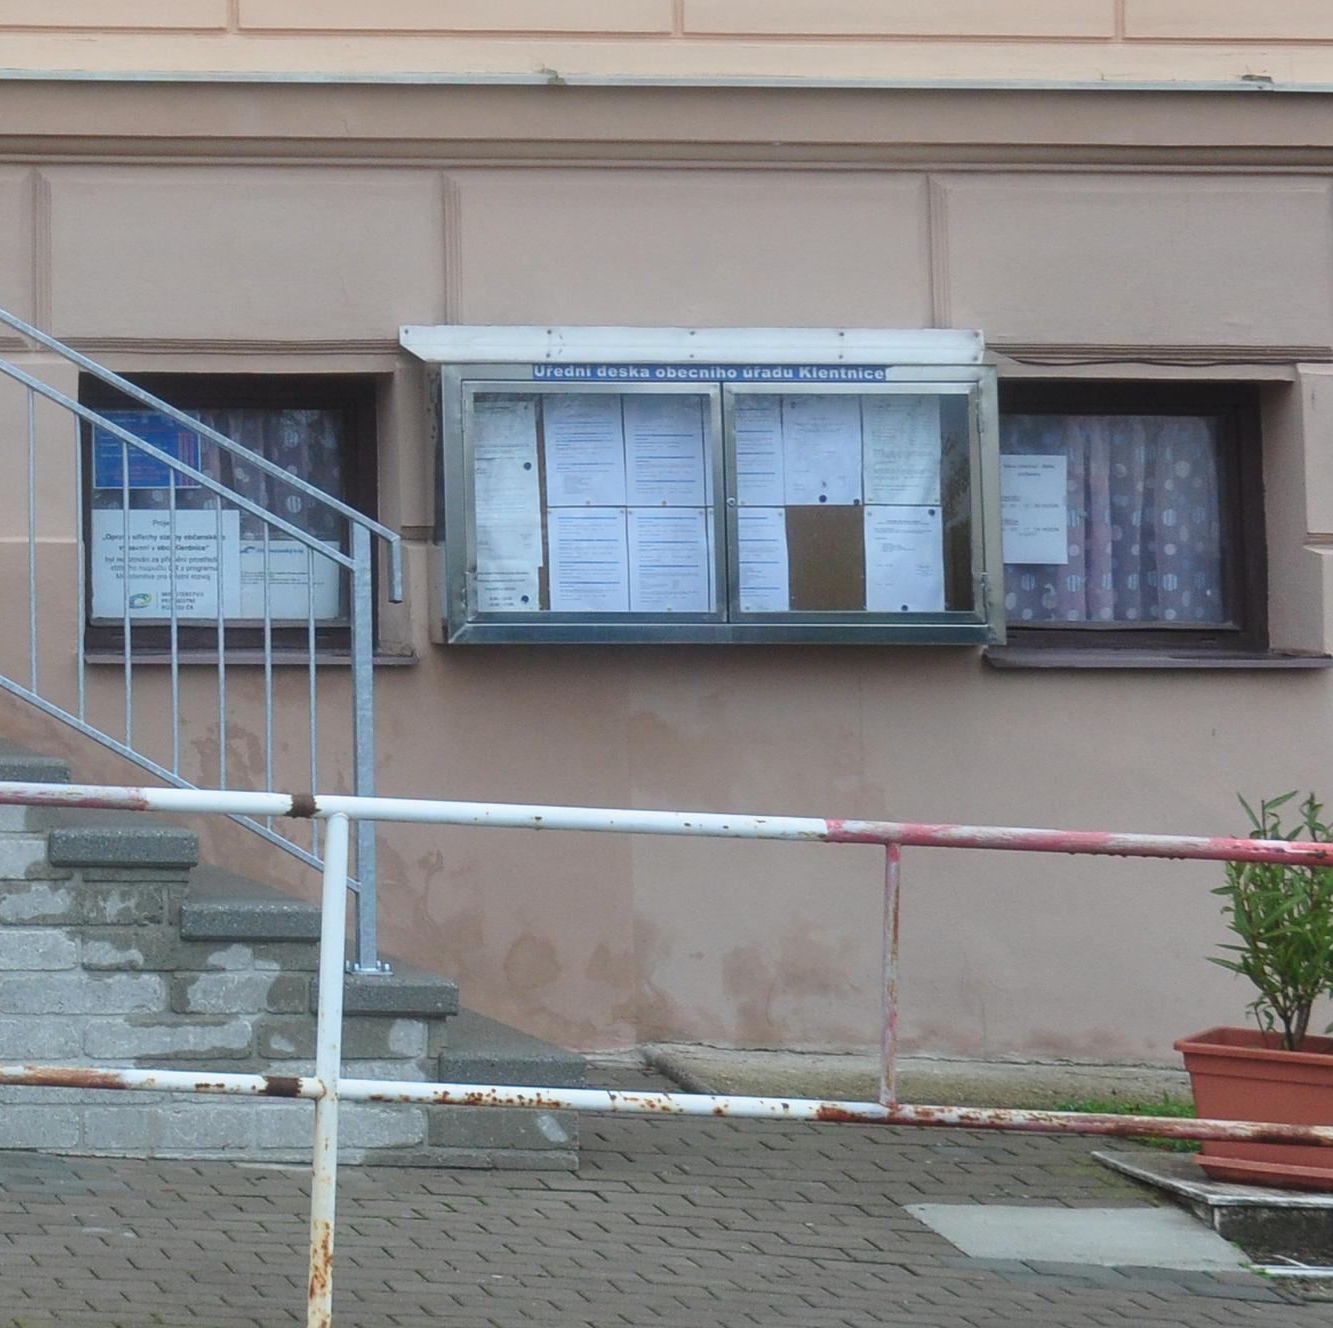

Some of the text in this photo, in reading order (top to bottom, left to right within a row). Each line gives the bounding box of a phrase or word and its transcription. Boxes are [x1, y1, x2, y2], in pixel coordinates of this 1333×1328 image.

[597, 364, 651, 380] deska
[655, 364, 737, 380] obecního
[798, 365, 886, 381] Klentnice
